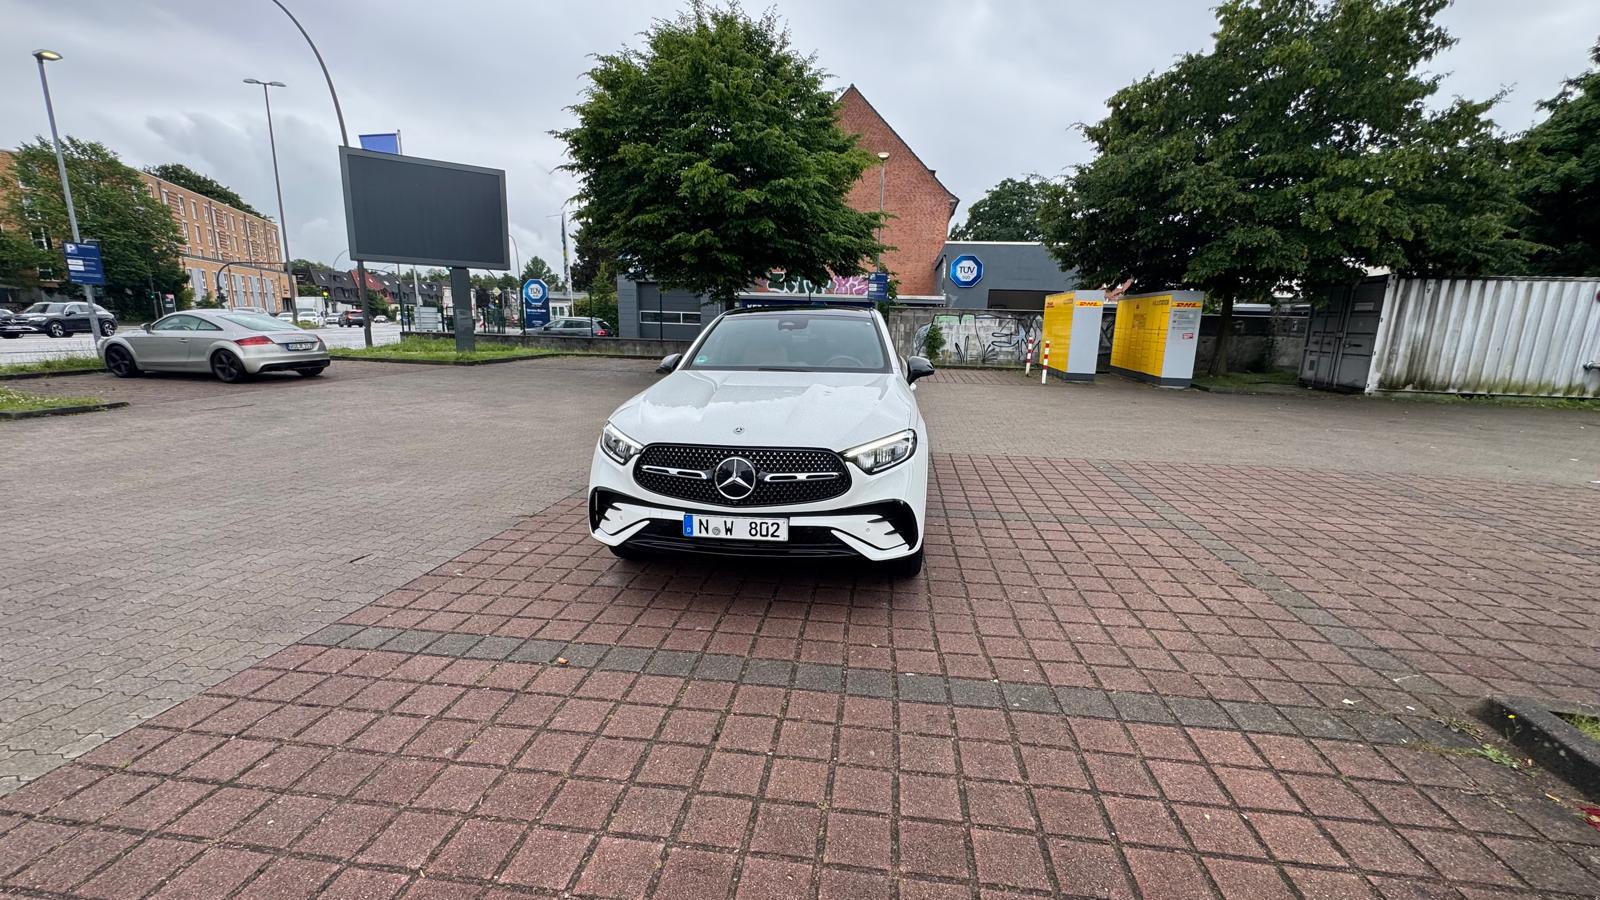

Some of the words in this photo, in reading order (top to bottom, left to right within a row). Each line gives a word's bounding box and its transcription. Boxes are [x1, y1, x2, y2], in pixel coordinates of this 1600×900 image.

[66, 244, 76, 253] P
[699, 519, 709, 534] N
[724, 520, 734, 536] W
[749, 521, 780, 538] 802
